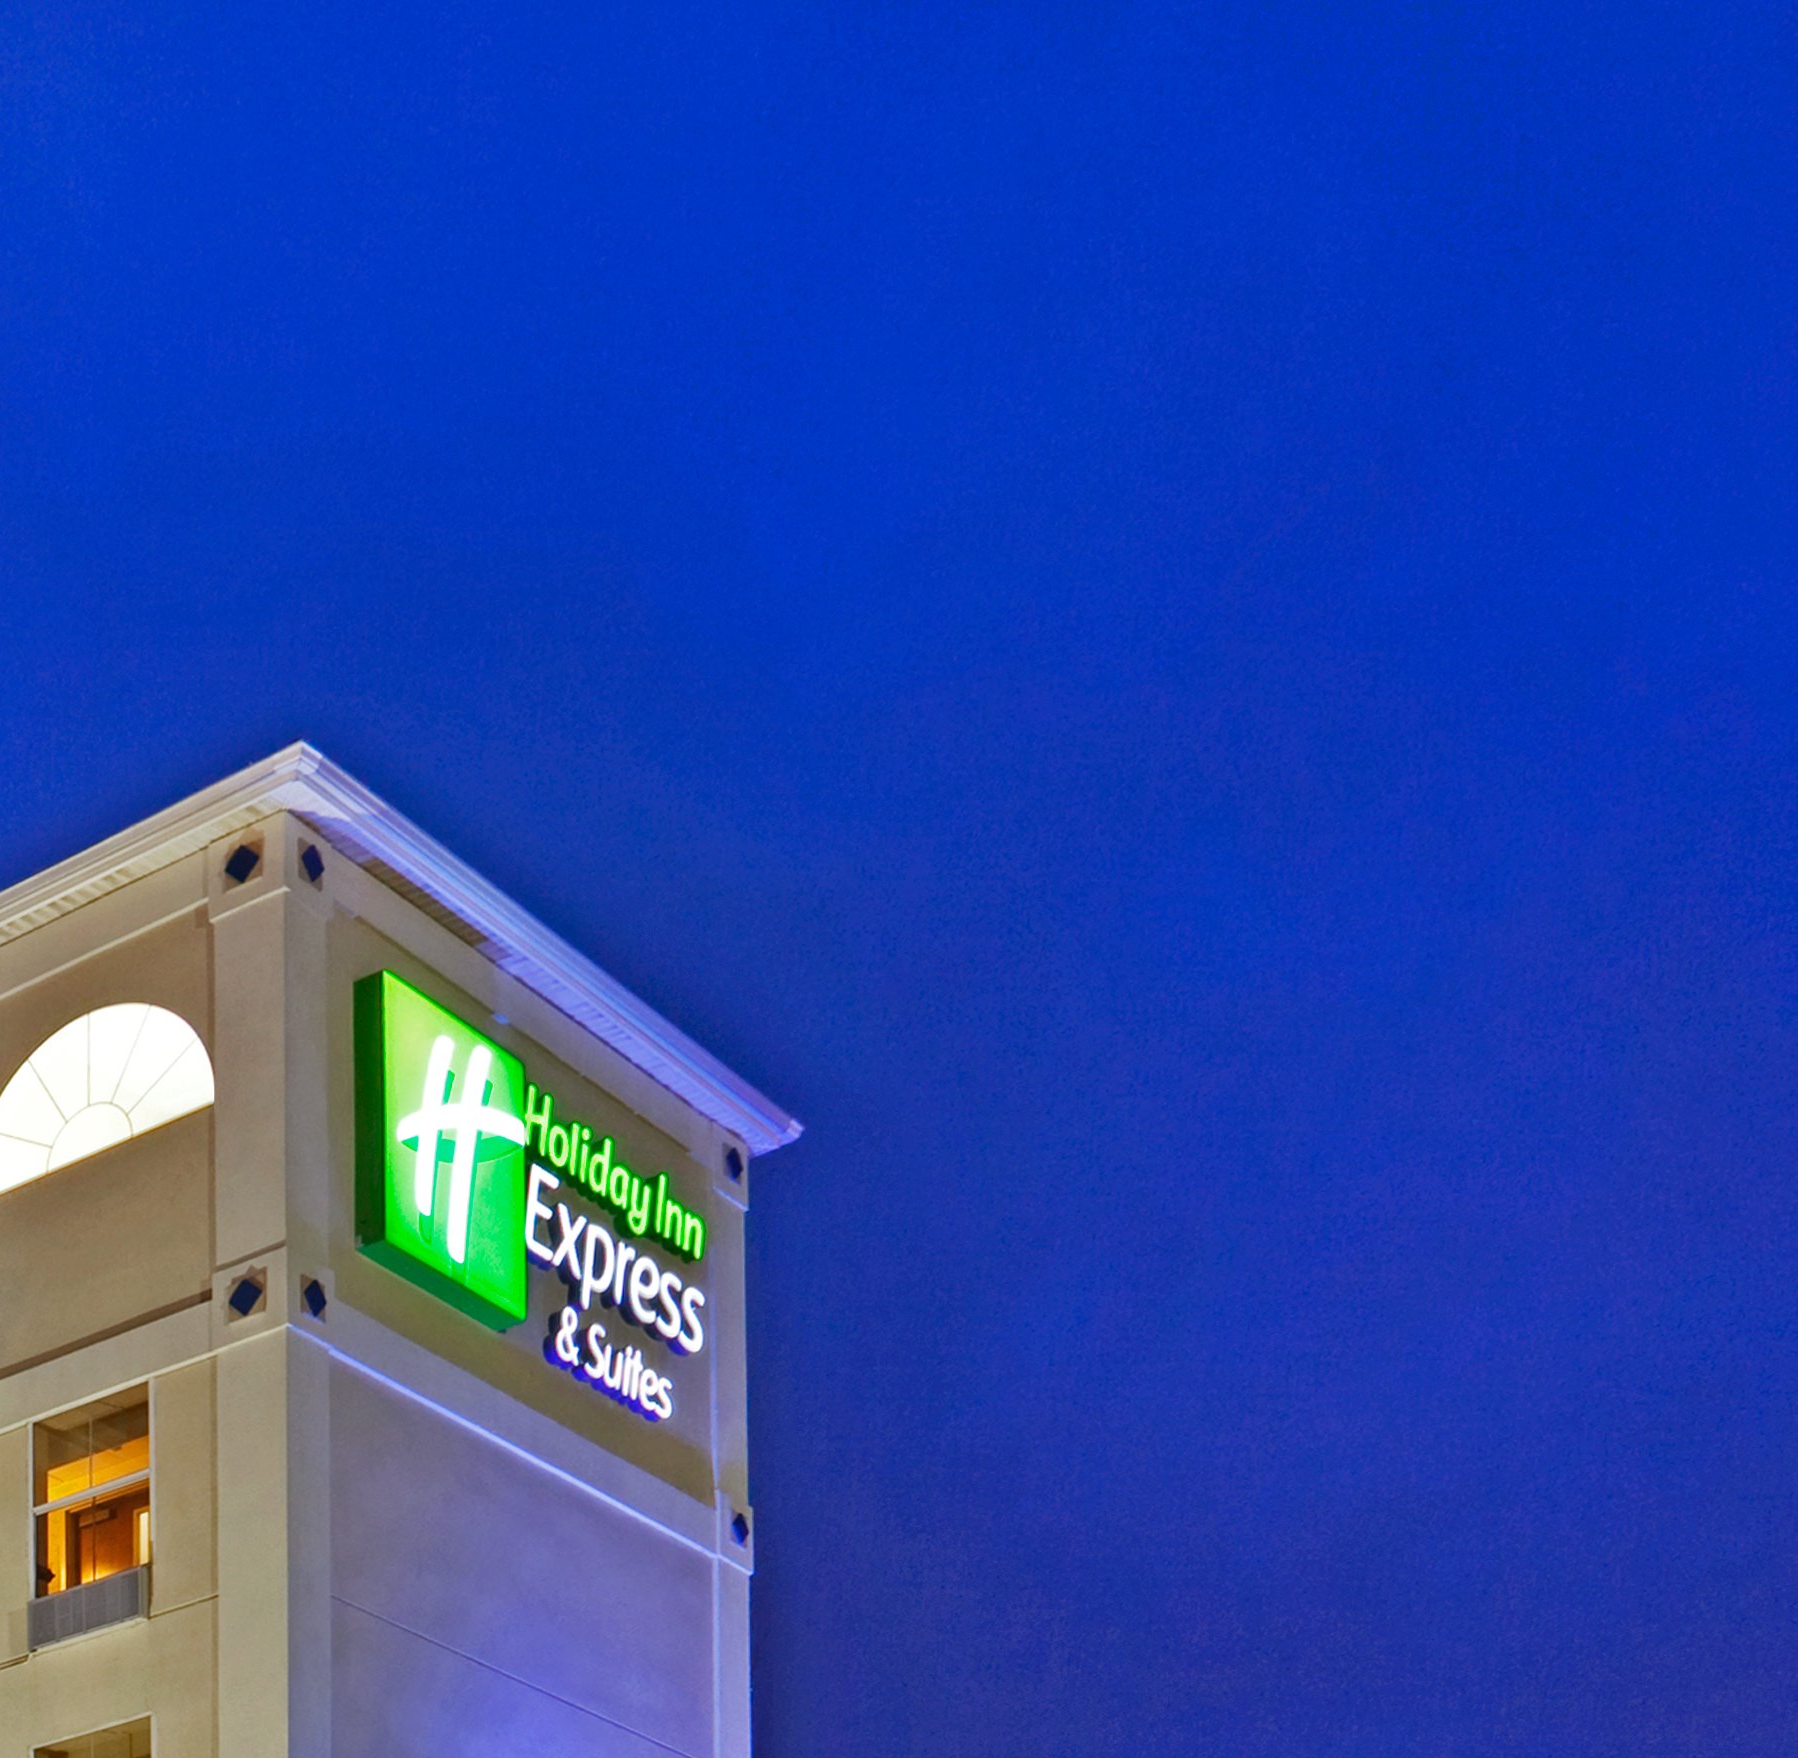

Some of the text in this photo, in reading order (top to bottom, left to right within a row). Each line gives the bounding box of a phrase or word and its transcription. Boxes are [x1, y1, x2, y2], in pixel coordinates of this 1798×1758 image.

[524, 1083, 704, 1260] Holiday Inn
[524, 1162, 706, 1354] Express
[555, 1305, 674, 1420] & Suites
